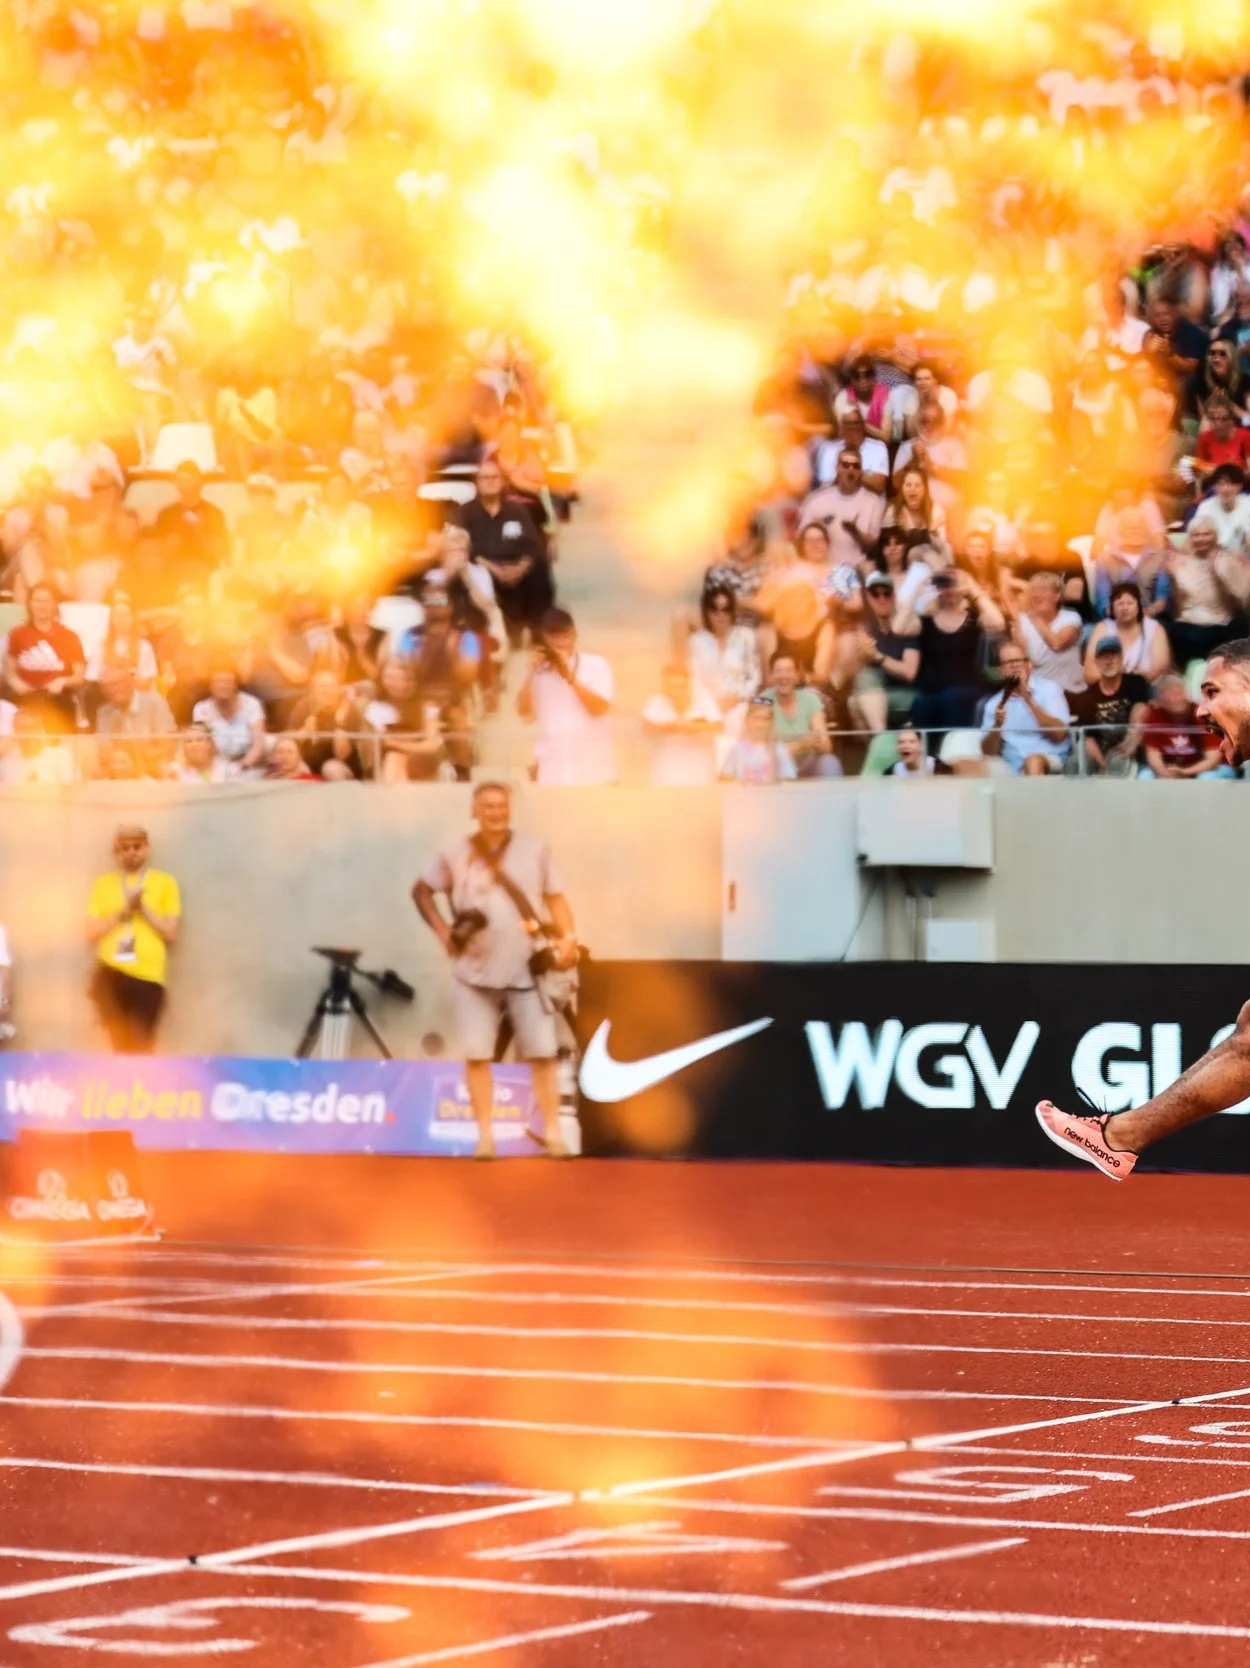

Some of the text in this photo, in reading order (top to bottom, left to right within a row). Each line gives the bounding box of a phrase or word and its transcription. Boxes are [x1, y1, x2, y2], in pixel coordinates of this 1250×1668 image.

[805, 1018, 1041, 1110] WGV
[210, 1081, 397, 1124] Dresden.
[1064, 1126, 1121, 1168] new balance
